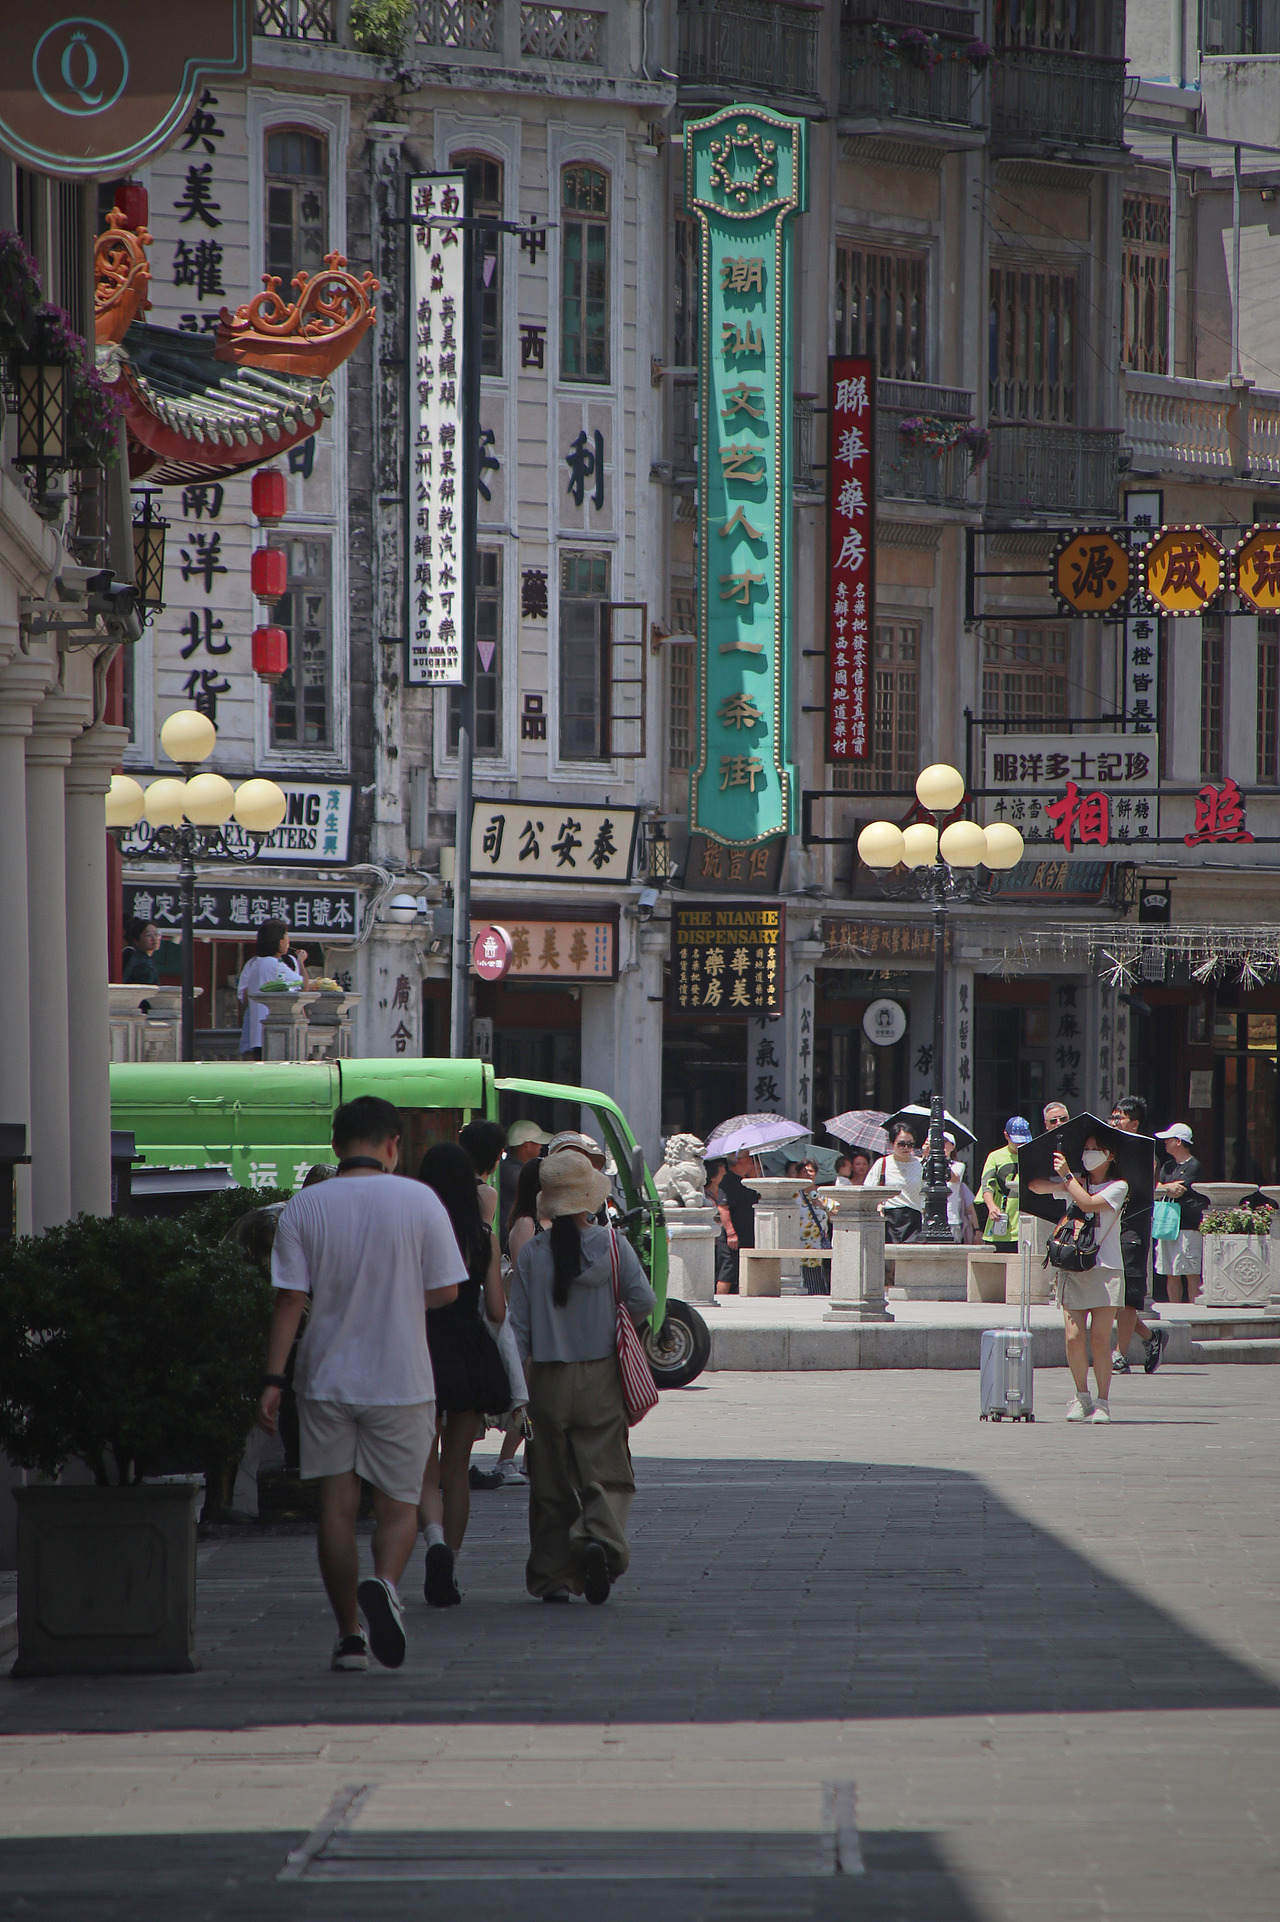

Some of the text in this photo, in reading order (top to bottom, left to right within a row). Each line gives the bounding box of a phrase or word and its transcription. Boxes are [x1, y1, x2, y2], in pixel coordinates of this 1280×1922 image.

[61, 41, 103, 105] Q
[172, 88, 226, 333] 英美罐
[413, 297, 434, 641] 南洋北貨 亞洲公司罐頭食品
[833, 375, 870, 572] 聯華藥房
[716, 255, 766, 793] 潮汕文艺人才一条街
[993, 752, 1151, 782] 珍記士多洋服
[482, 813, 618, 870] 泰安公司
[677, 910, 778, 926] THE NIANHE
[677, 929, 780, 945] DISPENSARY
[754, 1017, 782, 1116] 氣致
